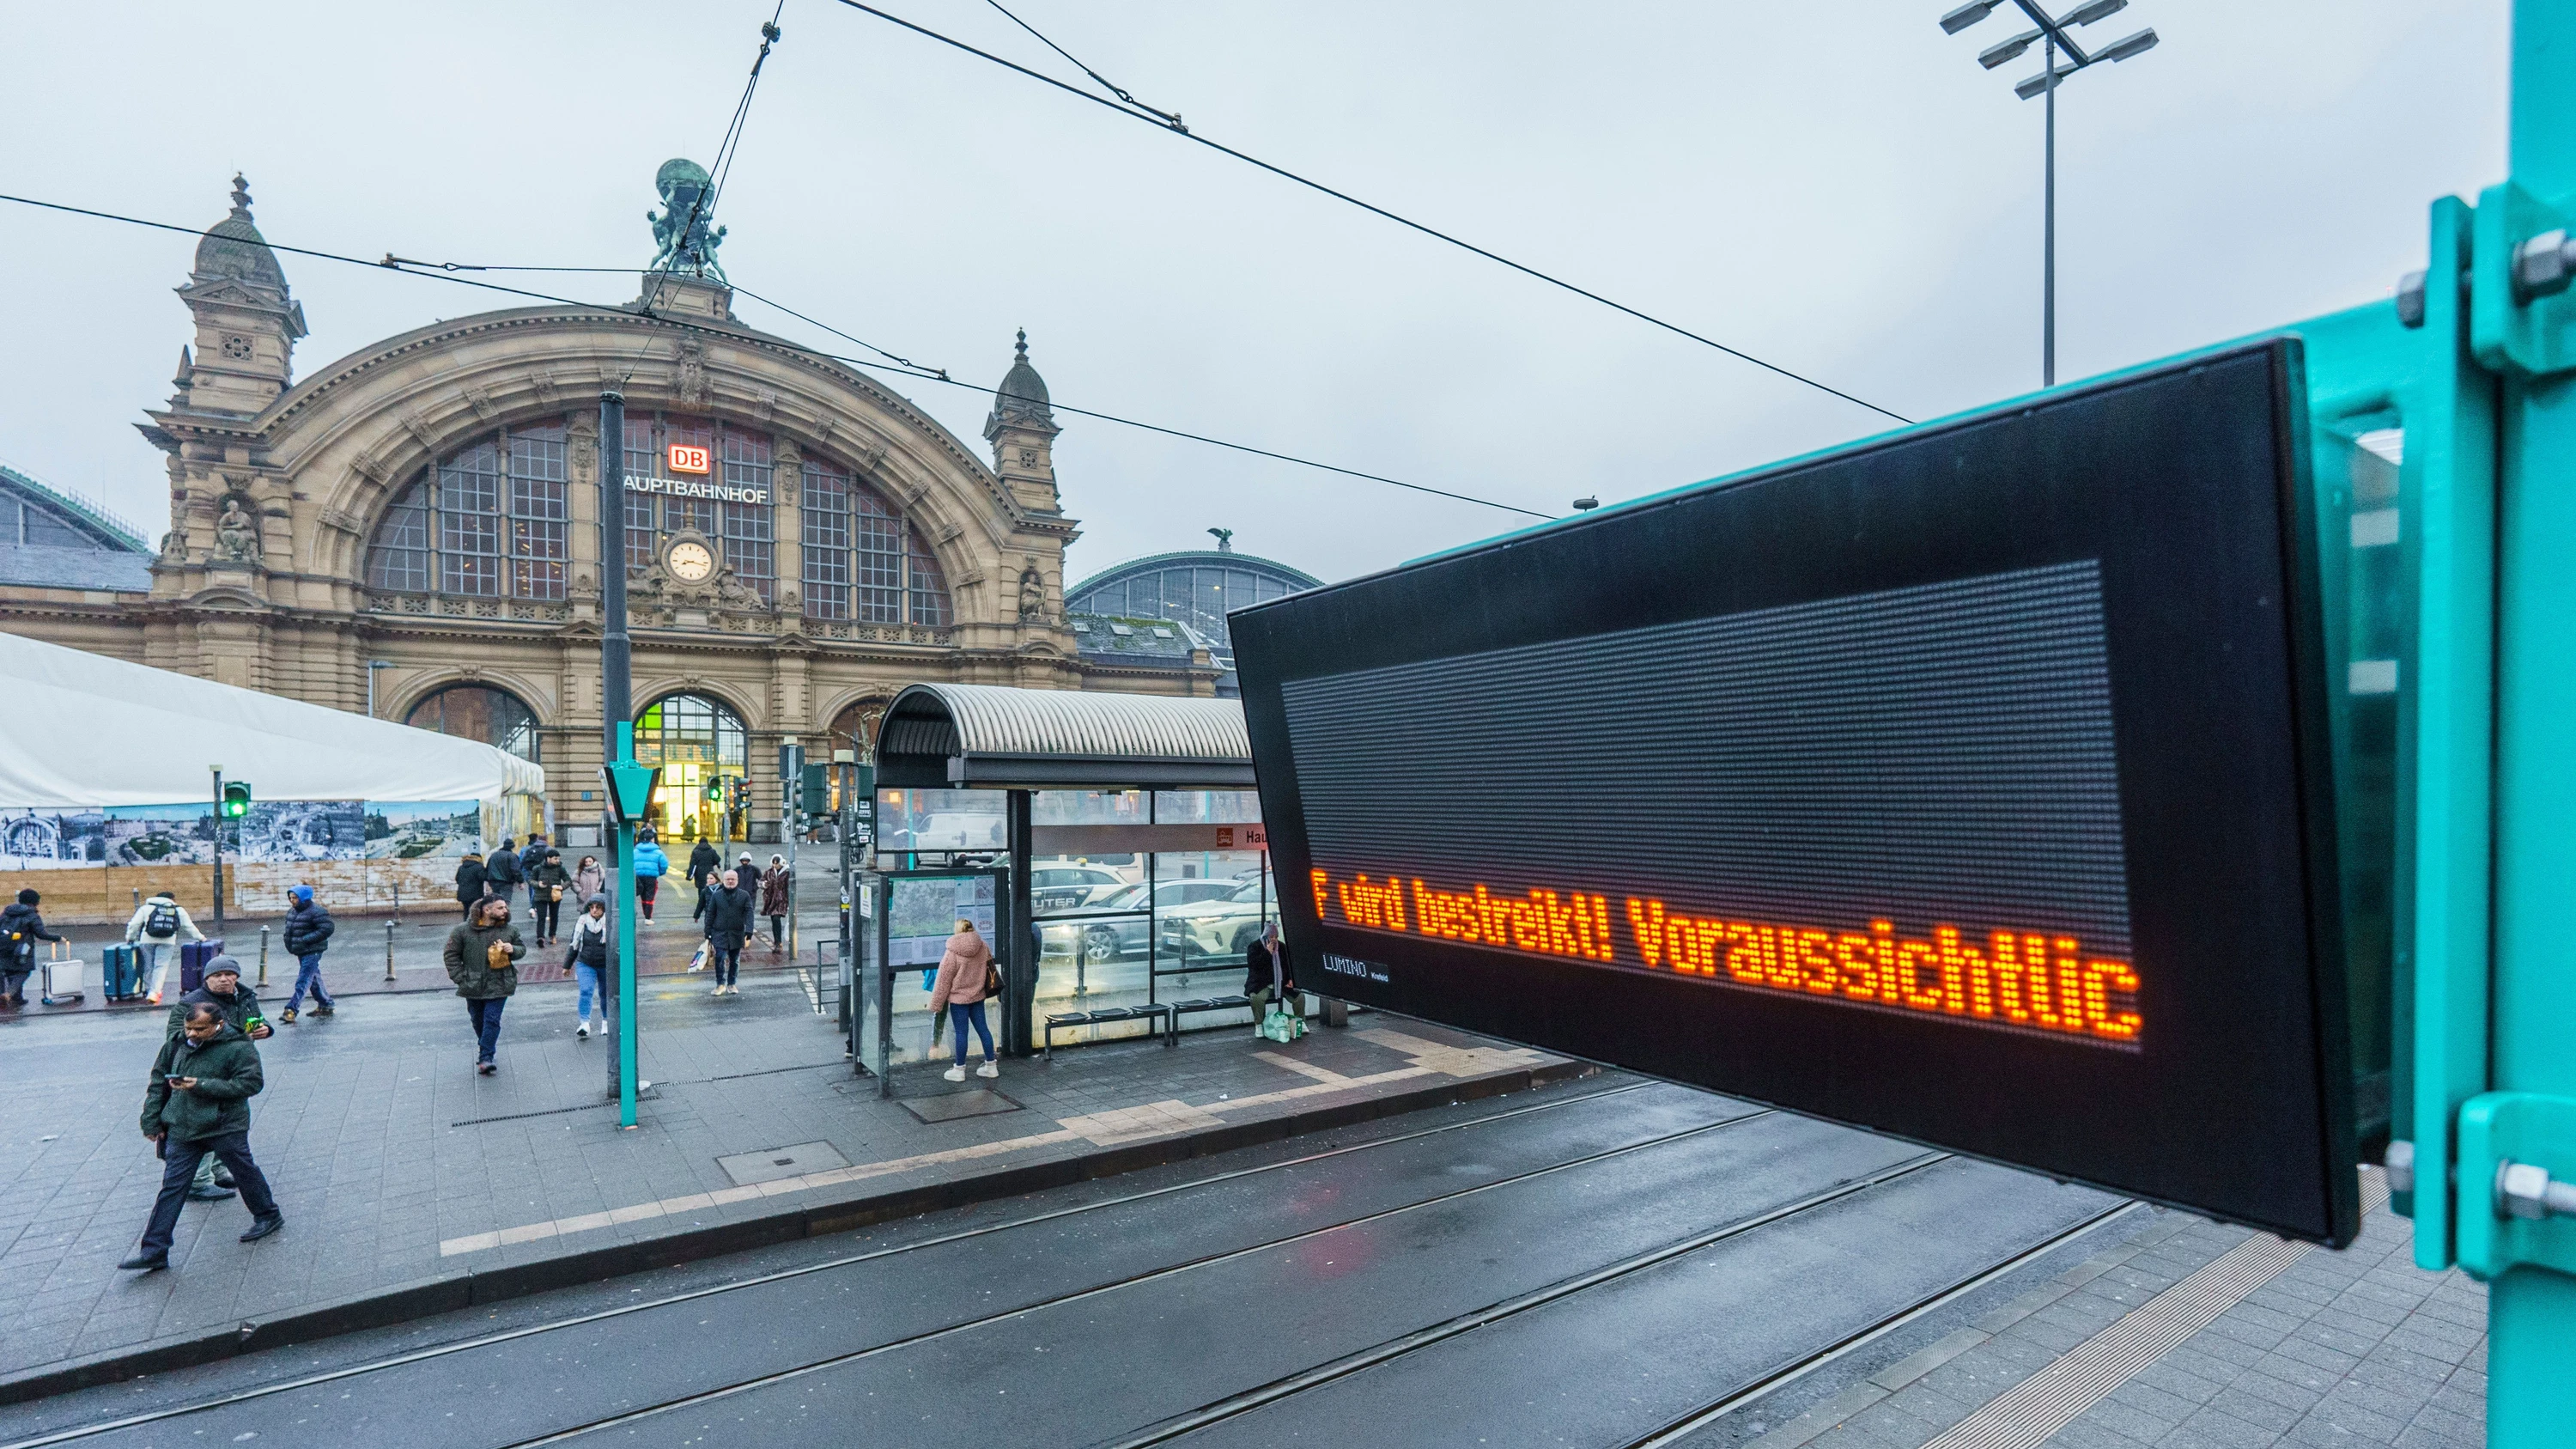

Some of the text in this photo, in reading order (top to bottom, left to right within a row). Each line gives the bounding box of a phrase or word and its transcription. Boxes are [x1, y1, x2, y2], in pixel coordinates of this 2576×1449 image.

[675, 449, 703, 467] DB
[624, 475, 767, 503] AUPTBAHNHOF
[1310, 868, 2143, 1040] F wird bestreikt! Voraussichtlic
[1322, 954, 1367, 977] LUMINO
